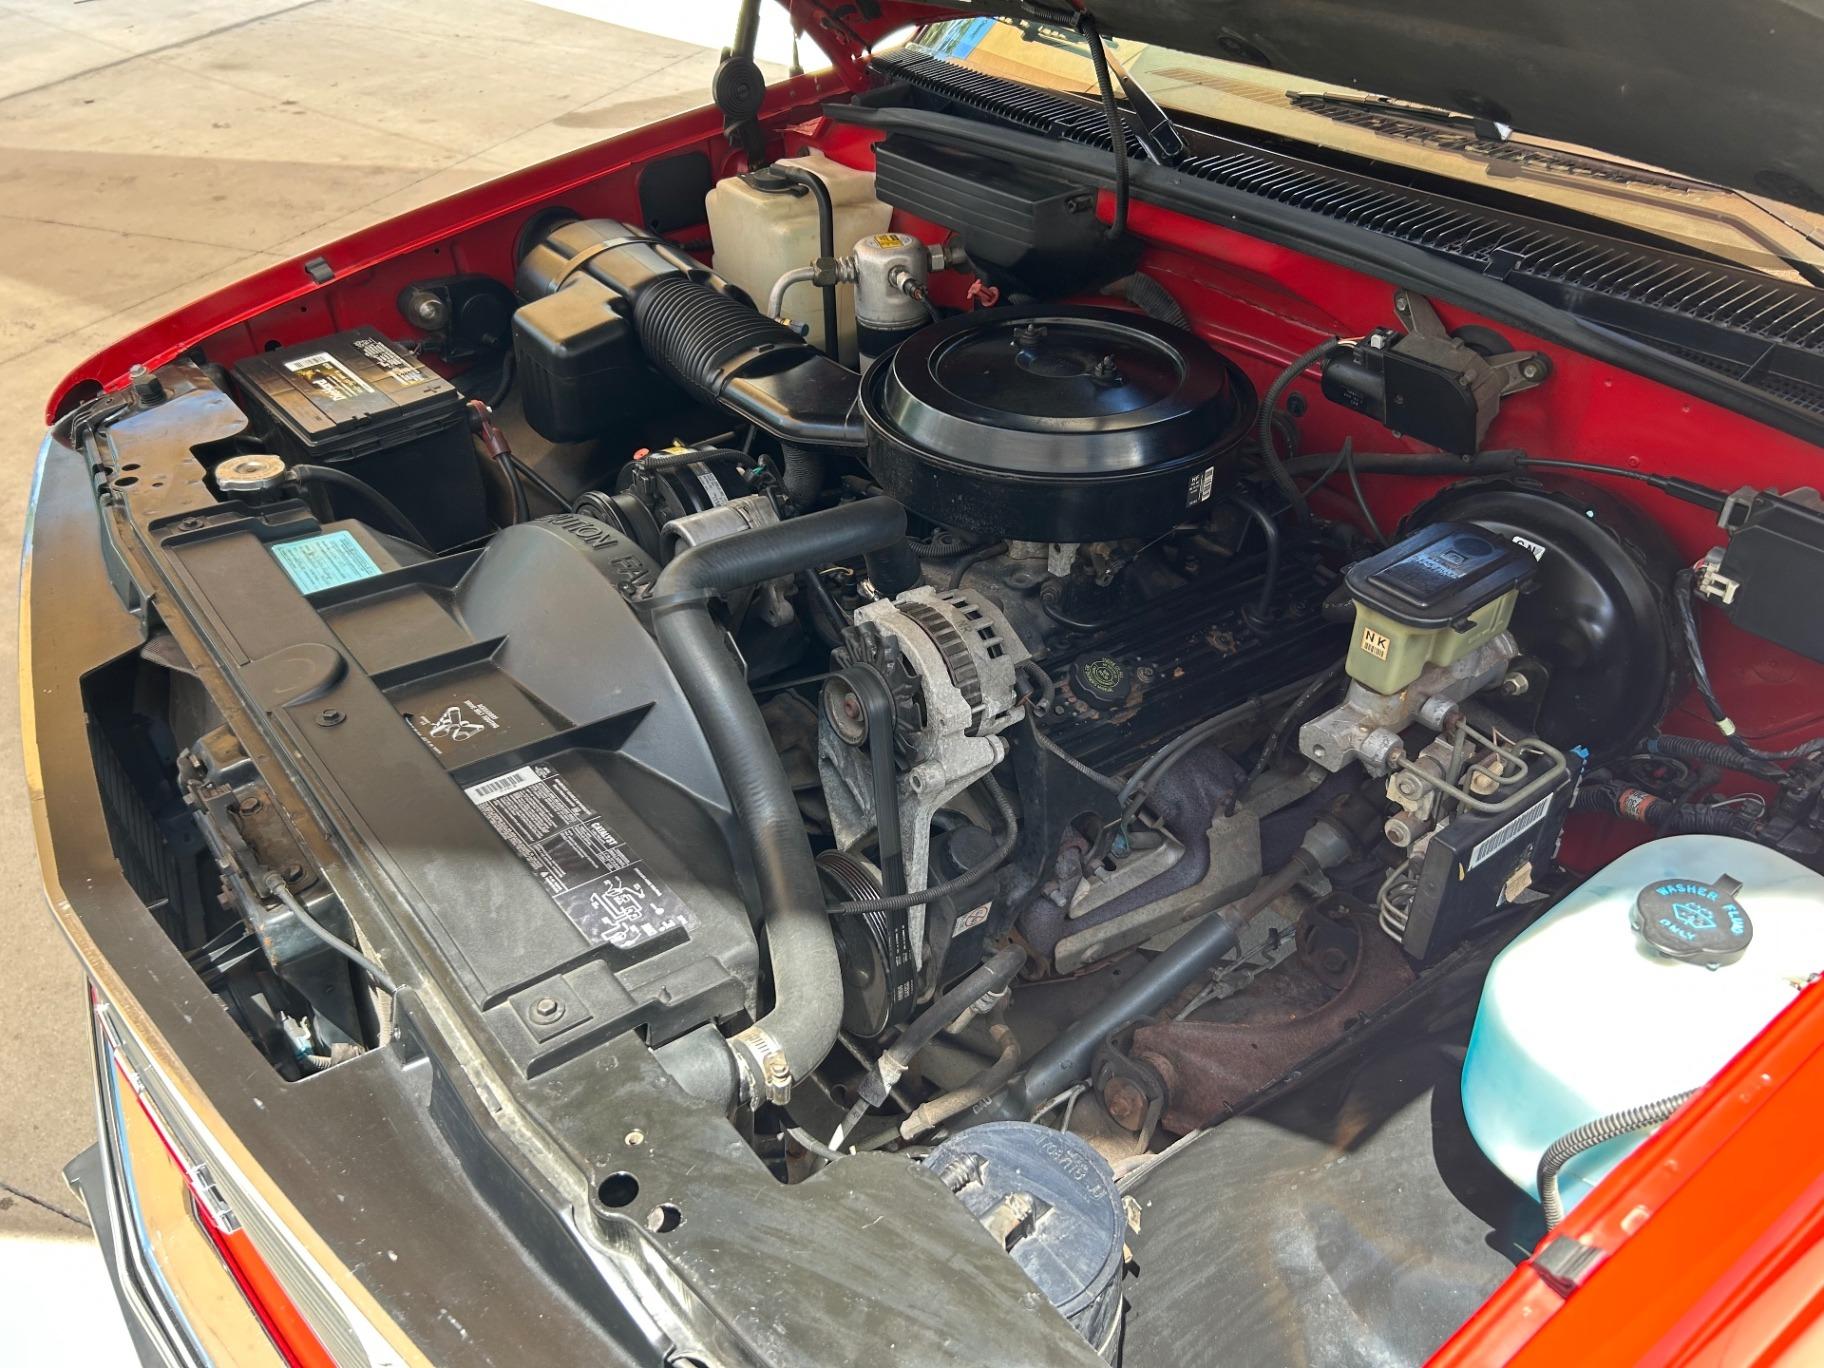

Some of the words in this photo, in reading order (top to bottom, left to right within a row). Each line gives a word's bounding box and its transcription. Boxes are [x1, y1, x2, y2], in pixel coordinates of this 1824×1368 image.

[611, 555, 657, 599] FAN
[590, 822, 618, 846] CATALYST
[1656, 884, 1719, 901] WASHER
[1722, 904, 1744, 935] FLUID
[1658, 918, 1697, 941] ONLY
